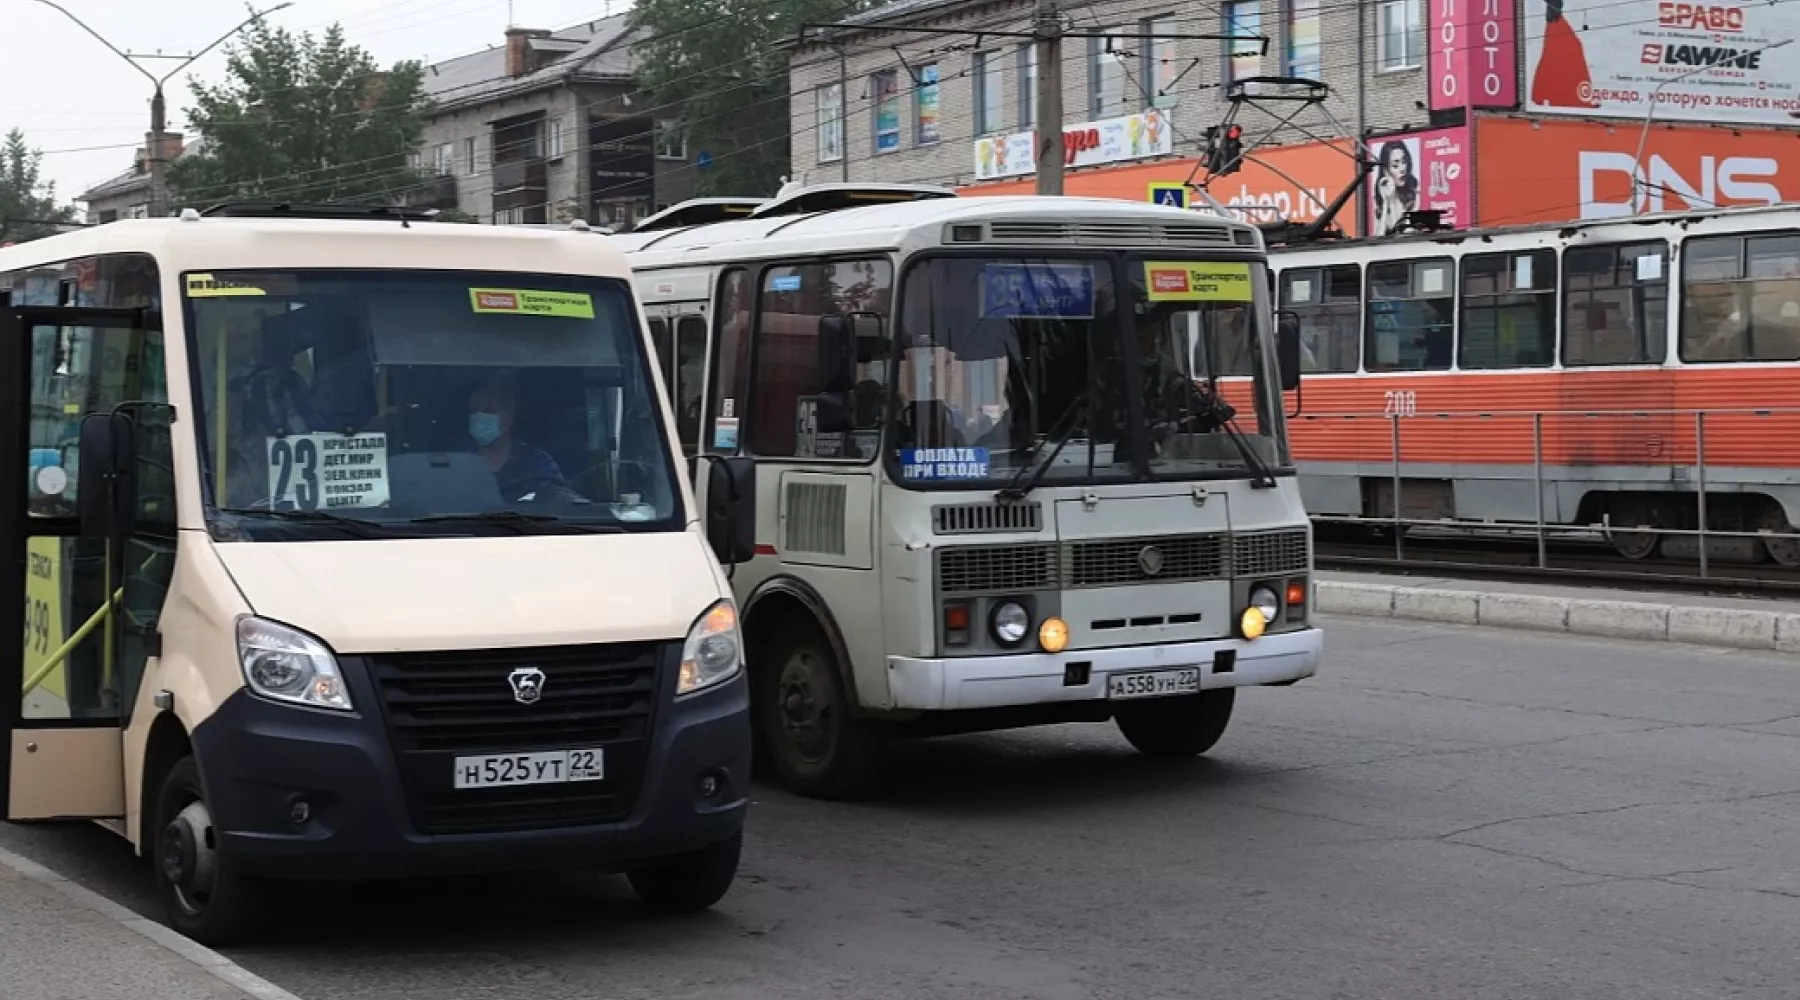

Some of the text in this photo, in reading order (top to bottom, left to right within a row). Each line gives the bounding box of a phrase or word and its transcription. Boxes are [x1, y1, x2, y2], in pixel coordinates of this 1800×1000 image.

[1665, 44, 1762, 69] LAWINE
[1714, 95, 1769, 109] хочется
[1772, 99, 1800, 110] нос
[1579, 151, 1782, 219] DNS
[1191, 270, 1247, 282] Транспортная
[1193, 284, 1218, 292] карта
[1384, 390, 1416, 418] 208
[323, 437, 385, 449] КРИСТАЛЛ
[914, 448, 976, 463] ОПЛАТА
[271, 438, 317, 513] 23
[903, 462, 988, 477] ПРИ ВХОДЕ
[325, 483, 373, 494] ВОКЗАЛ
[465, 751, 594, 784] Н525УТ 22
